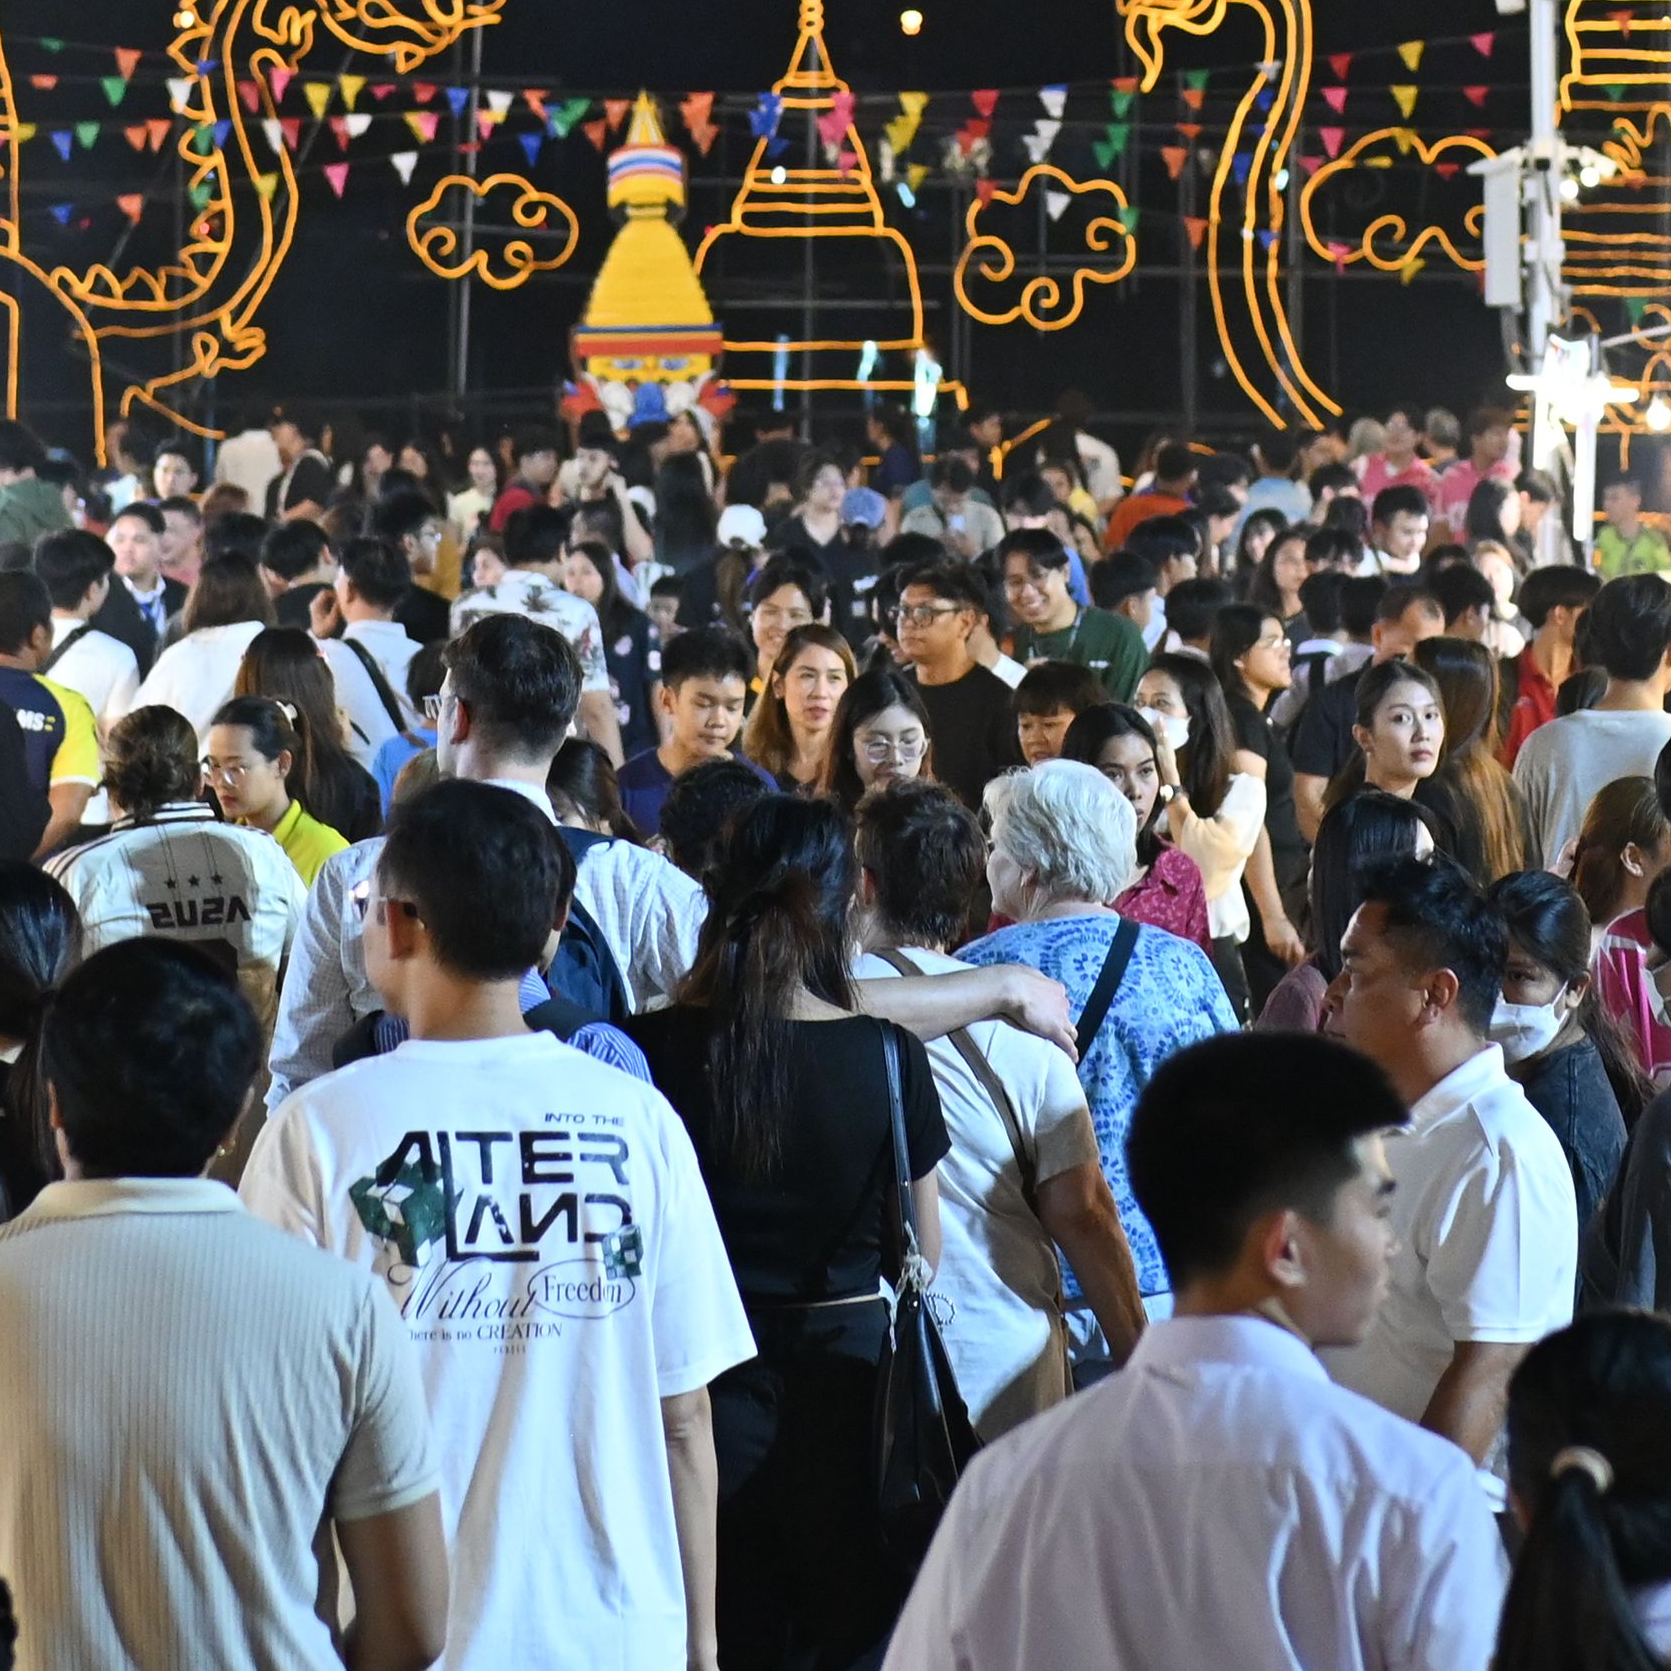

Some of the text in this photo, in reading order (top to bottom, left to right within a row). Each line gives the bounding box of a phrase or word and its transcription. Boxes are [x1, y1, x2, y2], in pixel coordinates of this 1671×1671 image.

[544, 1112, 624, 1127] INTO THE
[388, 1257, 539, 1320] Without
[442, 1329, 452, 1340] is
[457, 1330, 472, 1341] no
[477, 1322, 563, 1341] CREATION
